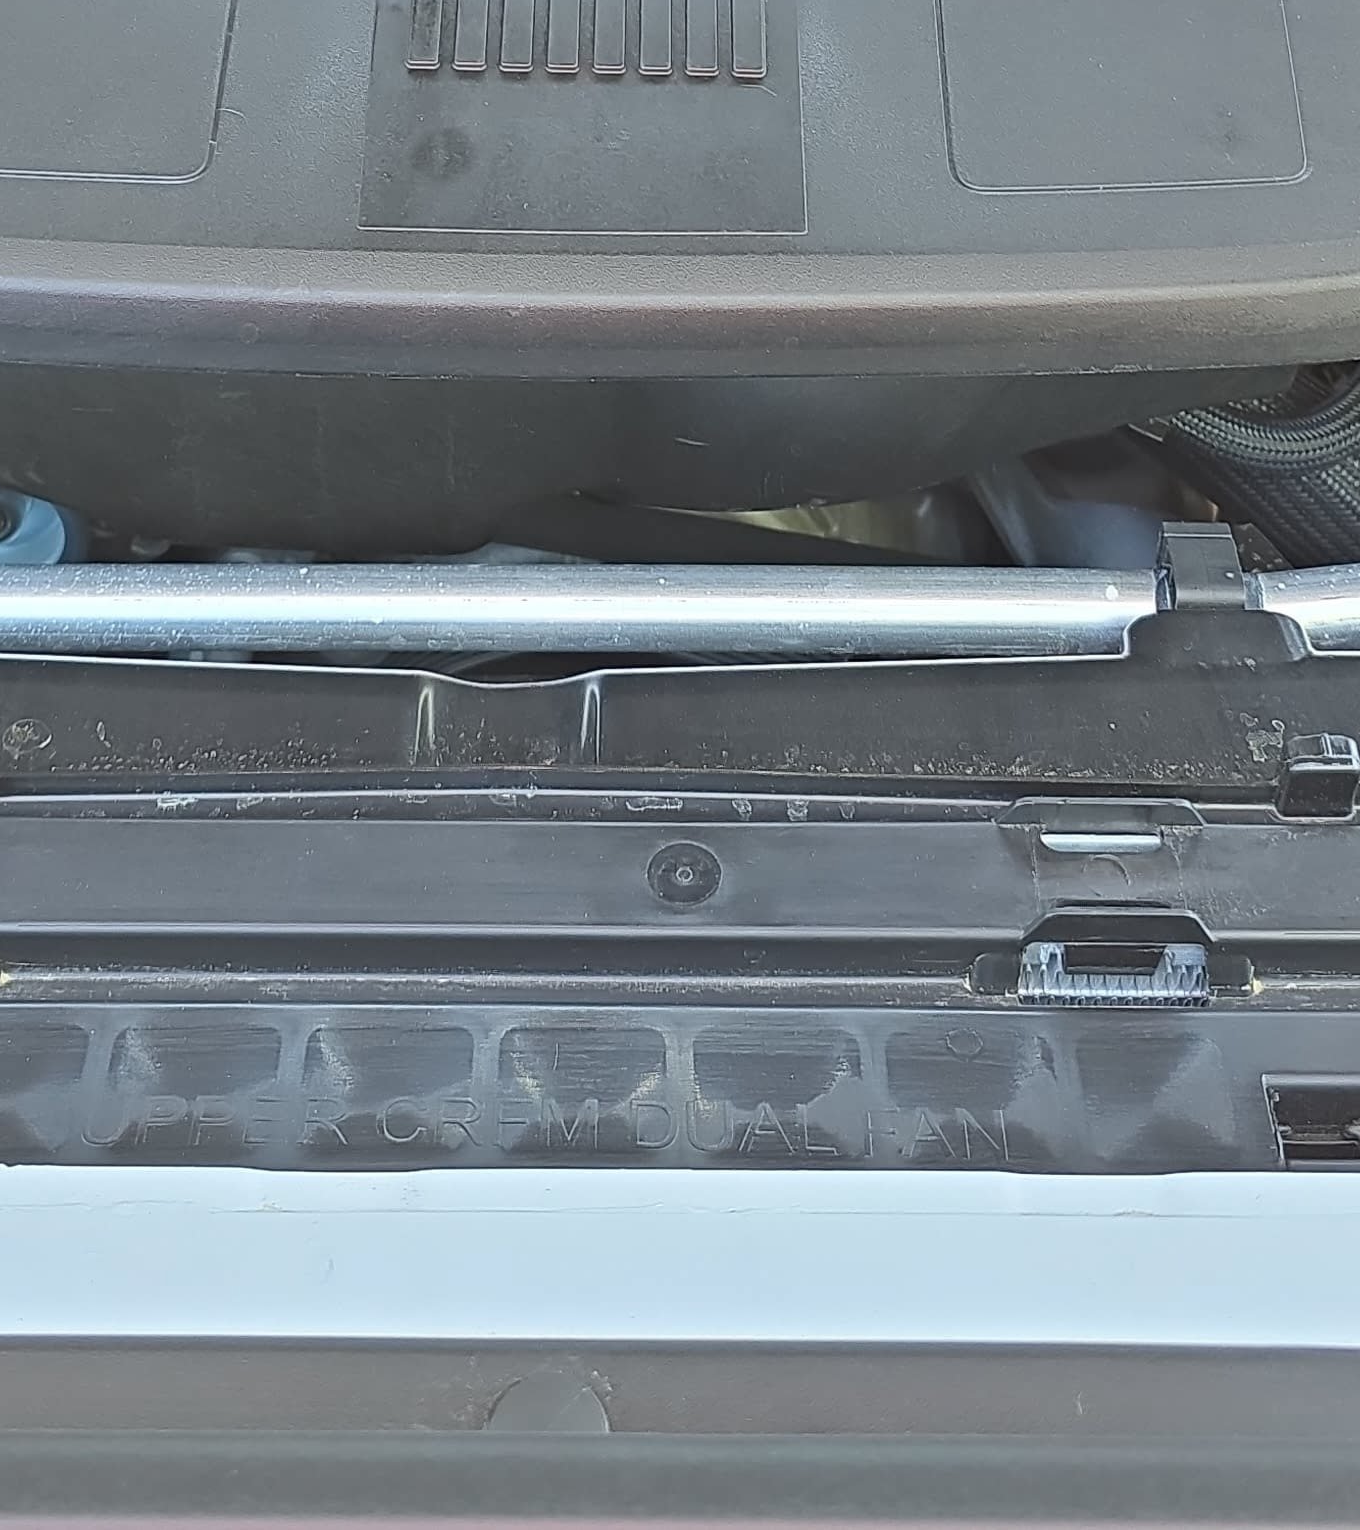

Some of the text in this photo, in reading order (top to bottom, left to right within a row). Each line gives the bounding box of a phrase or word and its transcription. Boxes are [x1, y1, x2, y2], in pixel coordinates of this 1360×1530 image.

[80, 1094, 350, 1149] UPPER
[628, 1098, 841, 1157] DUAL
[863, 1105, 1010, 1161] FAN
